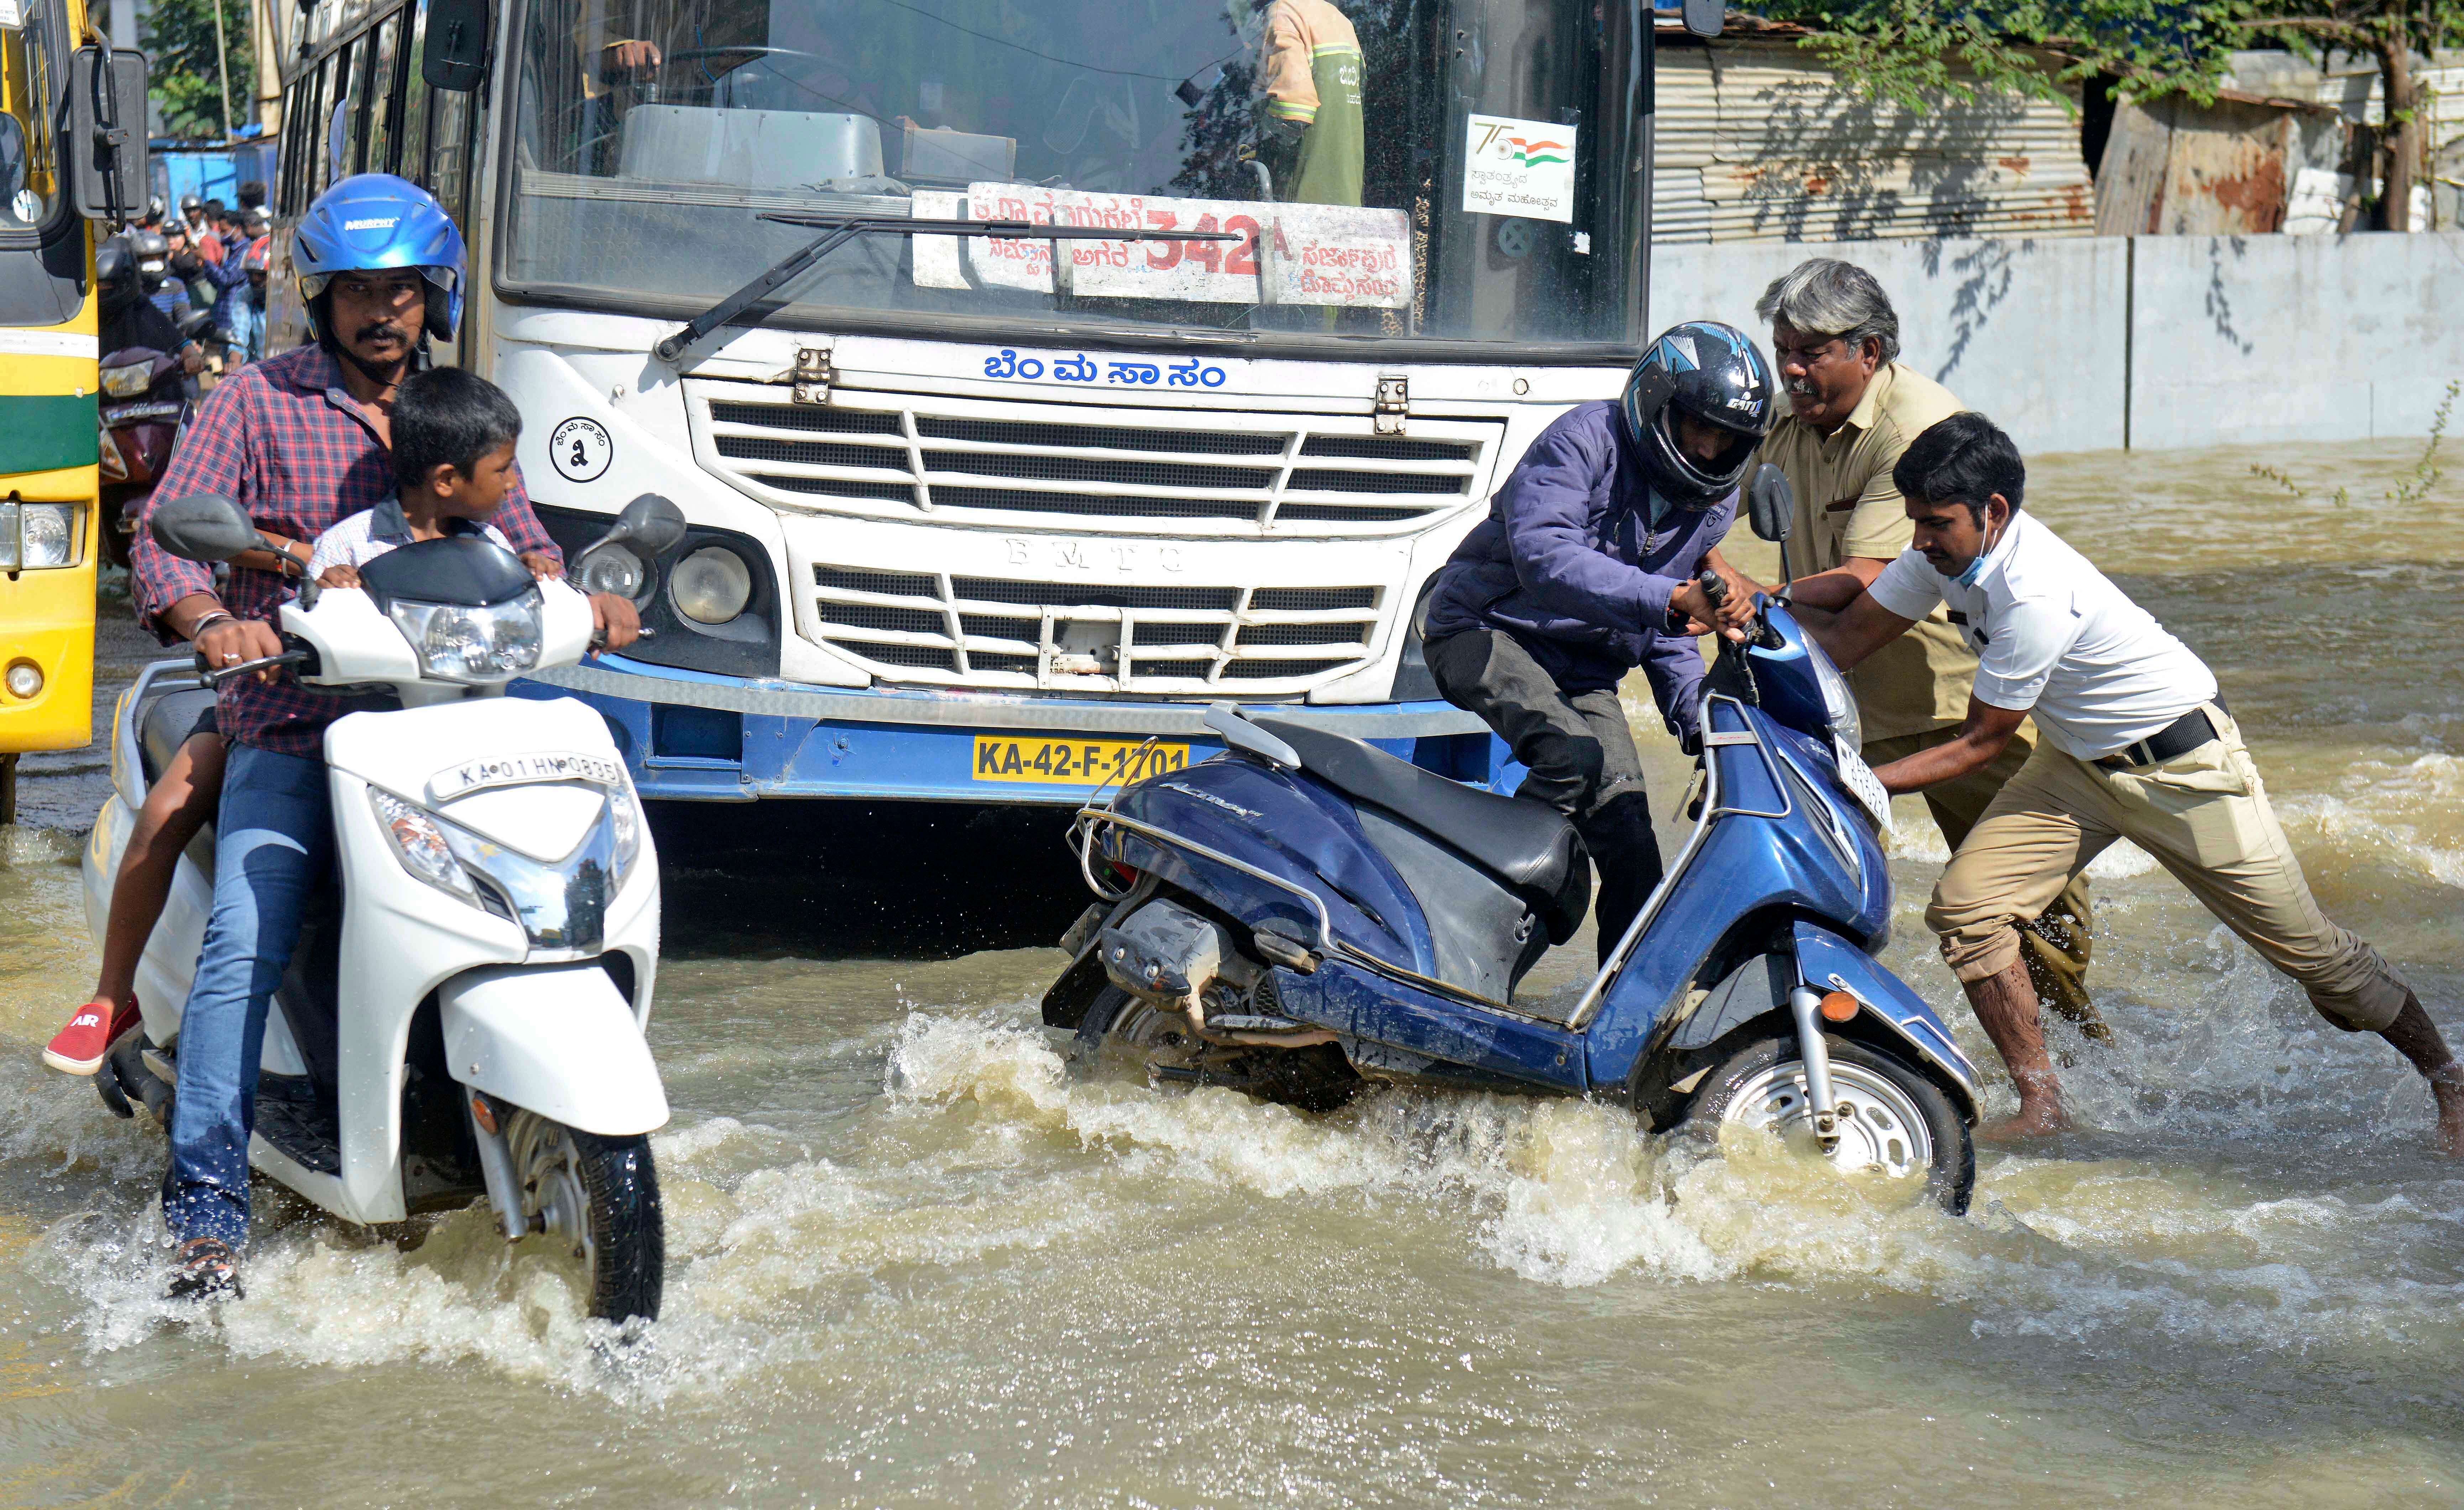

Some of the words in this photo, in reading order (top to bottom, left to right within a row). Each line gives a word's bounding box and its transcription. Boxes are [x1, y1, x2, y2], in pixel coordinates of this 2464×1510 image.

[1471, 170, 1528, 188] ಸ್ವಾತಂತ್ರ್ಯದ
[1471, 190, 1503, 206] ಅಮೃತ
[1508, 193, 1558, 211] ಮಹೋತ್ಸವ
[1072, 241, 1128, 267] ಅಗರ
[70, 1014, 99, 1028] AIR
